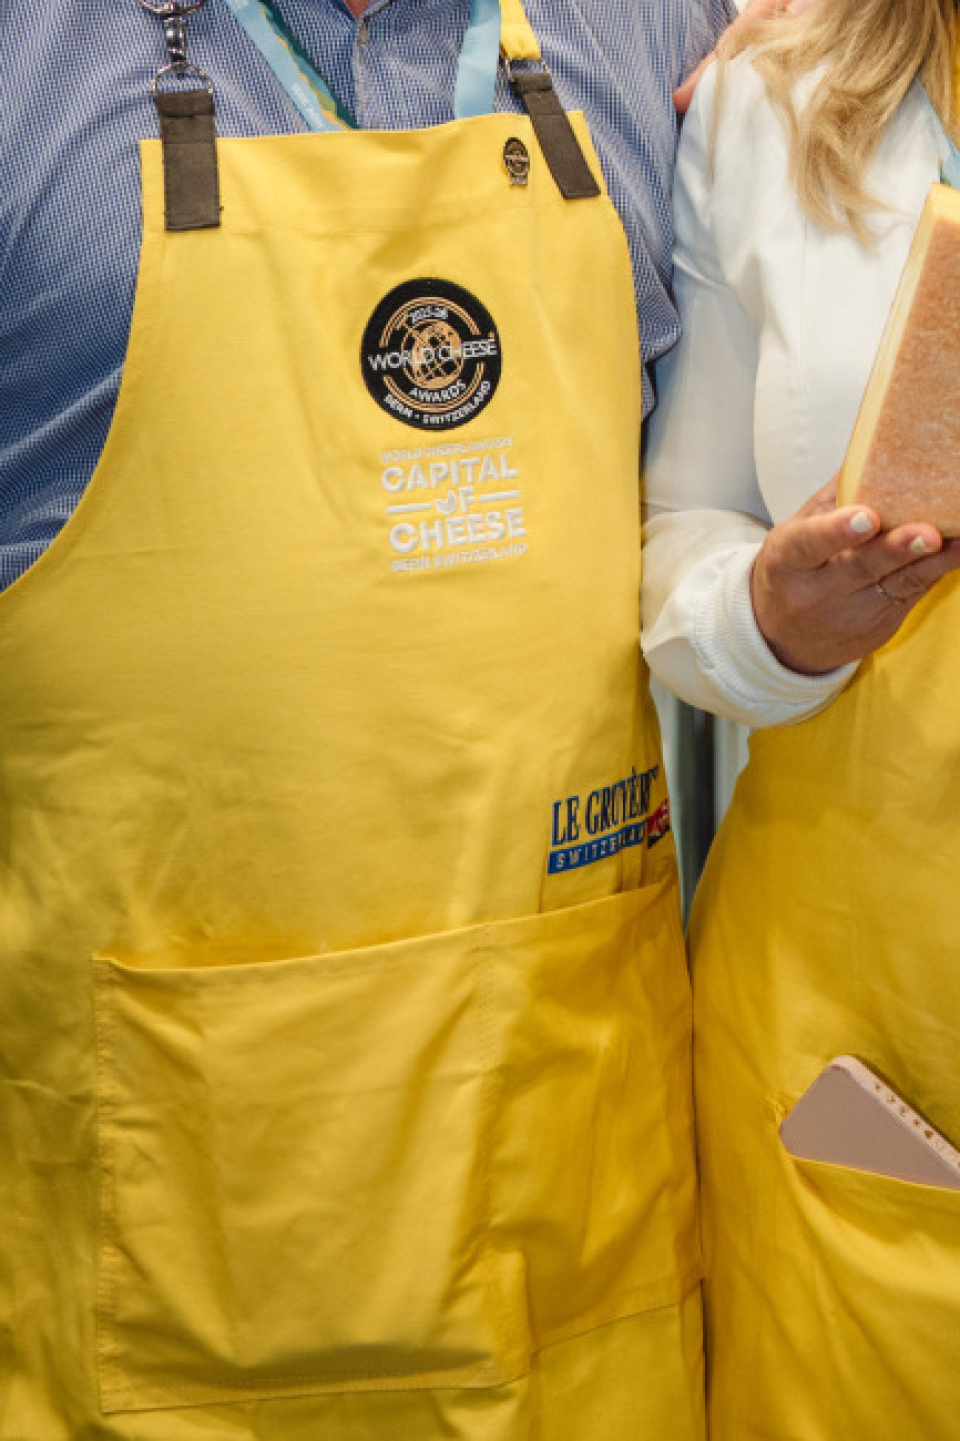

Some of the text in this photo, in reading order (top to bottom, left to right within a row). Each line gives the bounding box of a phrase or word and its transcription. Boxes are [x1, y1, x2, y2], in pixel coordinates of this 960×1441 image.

[367, 338, 498, 371] WORLD CHEESE
[410, 379, 466, 402] AWARDS
[381, 454, 519, 493] CAPITAL
[434, 486, 475, 515] OF
[389, 507, 527, 553] CHEESE
[552, 795, 581, 847] LE
